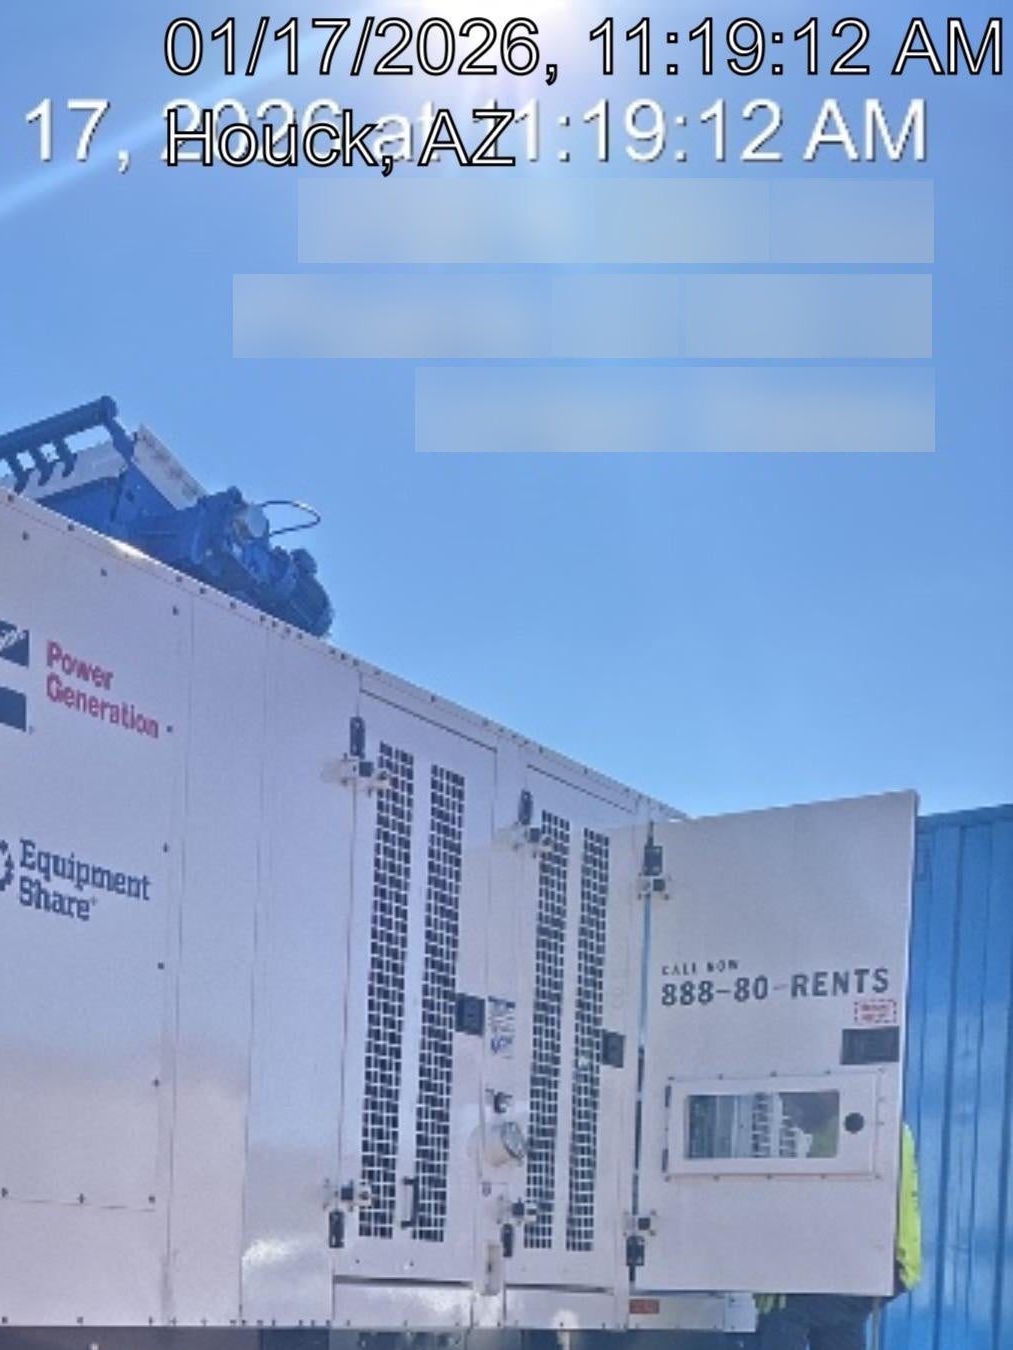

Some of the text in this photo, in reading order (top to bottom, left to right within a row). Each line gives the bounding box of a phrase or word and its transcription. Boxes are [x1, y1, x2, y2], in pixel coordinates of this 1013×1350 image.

[47, 640, 114, 690] Power
[46, 672, 159, 739] Generation
[19, 838, 152, 901] Equipment
[19, 875, 90, 921] Share
